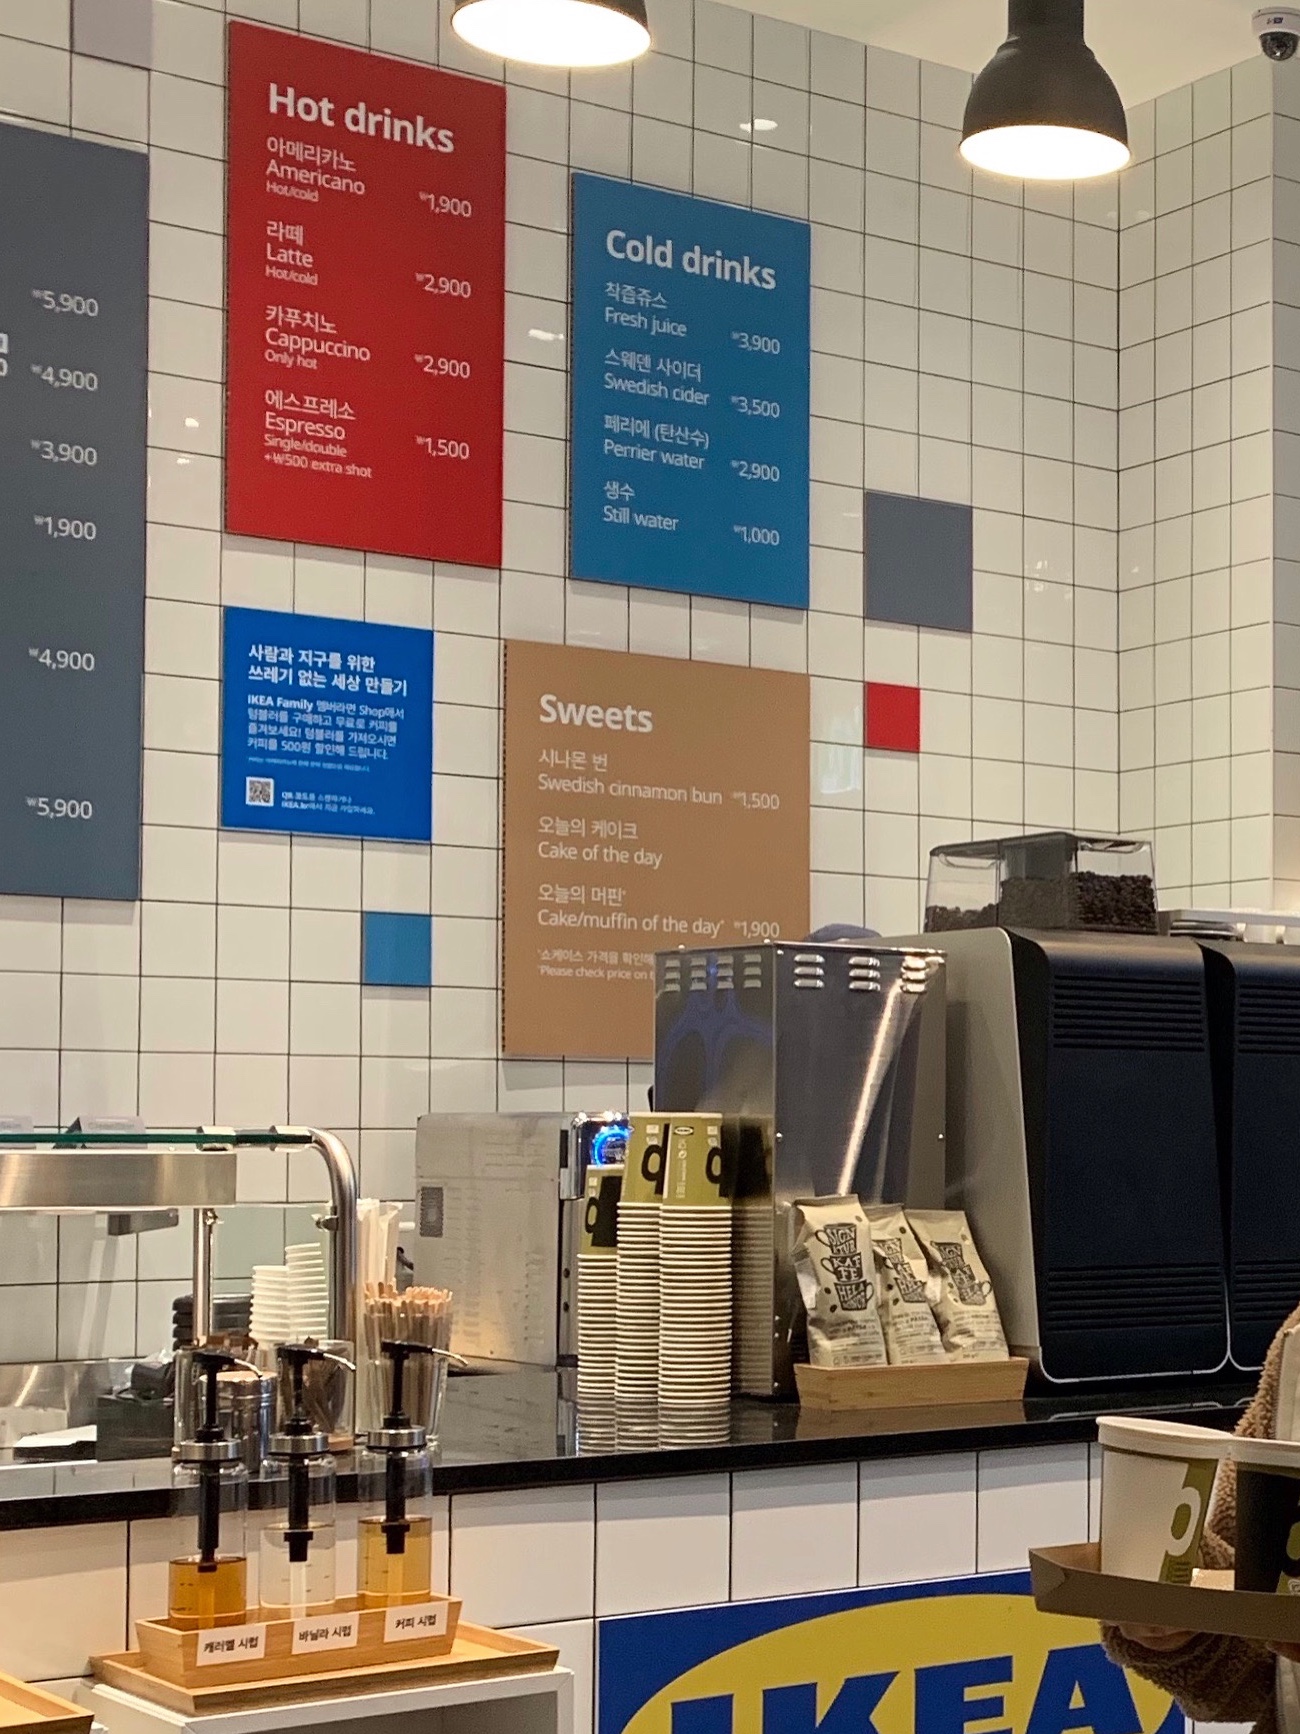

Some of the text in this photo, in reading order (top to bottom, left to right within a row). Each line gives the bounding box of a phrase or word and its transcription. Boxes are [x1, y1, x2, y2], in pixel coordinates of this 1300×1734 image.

[269, 82, 455, 153] Hot drinks
[267, 136, 357, 171] 아메리카노
[266, 159, 365, 195] Americano
[266, 180, 319, 202] Hot/cold
[266, 221, 304, 246] 라떼
[266, 243, 313, 268] Latte
[606, 229, 777, 290] Cold drinks
[265, 265, 318, 285] Hot/cold
[605, 281, 668, 310] 착즙쥬스
[266, 305, 337, 334] 카푸치노
[605, 306, 687, 337] Fresh juice
[265, 327, 371, 362] Cappuccino
[265, 349, 317, 370] Only hot
[604, 349, 701, 382] 스웨덴 사이더
[604, 372, 710, 406] Swedish cider
[265, 389, 356, 420] 에스프레소
[265, 412, 346, 440] Espresso
[604, 414, 709, 450] 페리에 (탄산수)
[264, 434, 347, 457] Single/double
[604, 439, 706, 469] Perrier water
[311, 459, 343, 474] extra
[345, 463, 372, 478] shot
[603, 480, 635, 501] 생수
[603, 505, 679, 531] Still water
[249, 644, 376, 673] 사람과 지구를 위한
[248, 665, 408, 697] 쓰레기 없는 세상 만들기
[247, 694, 274, 706] IKEA
[276, 697, 313, 712] Family
[540, 694, 653, 733] Sweets
[538, 749, 608, 772] 시나몬 번
[538, 773, 604, 795] Swedish
[609, 780, 687, 802] cinnamon
[692, 786, 722, 805] bun
[538, 816, 638, 840] 오늘의 케이크
[538, 841, 663, 869] Cake of the day
[538, 883, 586, 904] 오늘의
[537, 909, 638, 930] Cake/muffin
[642, 915, 659, 931] of
[662, 916, 688, 933] the
[575, 966, 605, 978] check
[607, 969, 631, 981] price
[633, 970, 647, 980] on
[298, 1625, 352, 1643] 바닐라 시럽
[395, 1614, 437, 1629] 커피 시럽
[239, 1636, 259, 1650] 시럽
